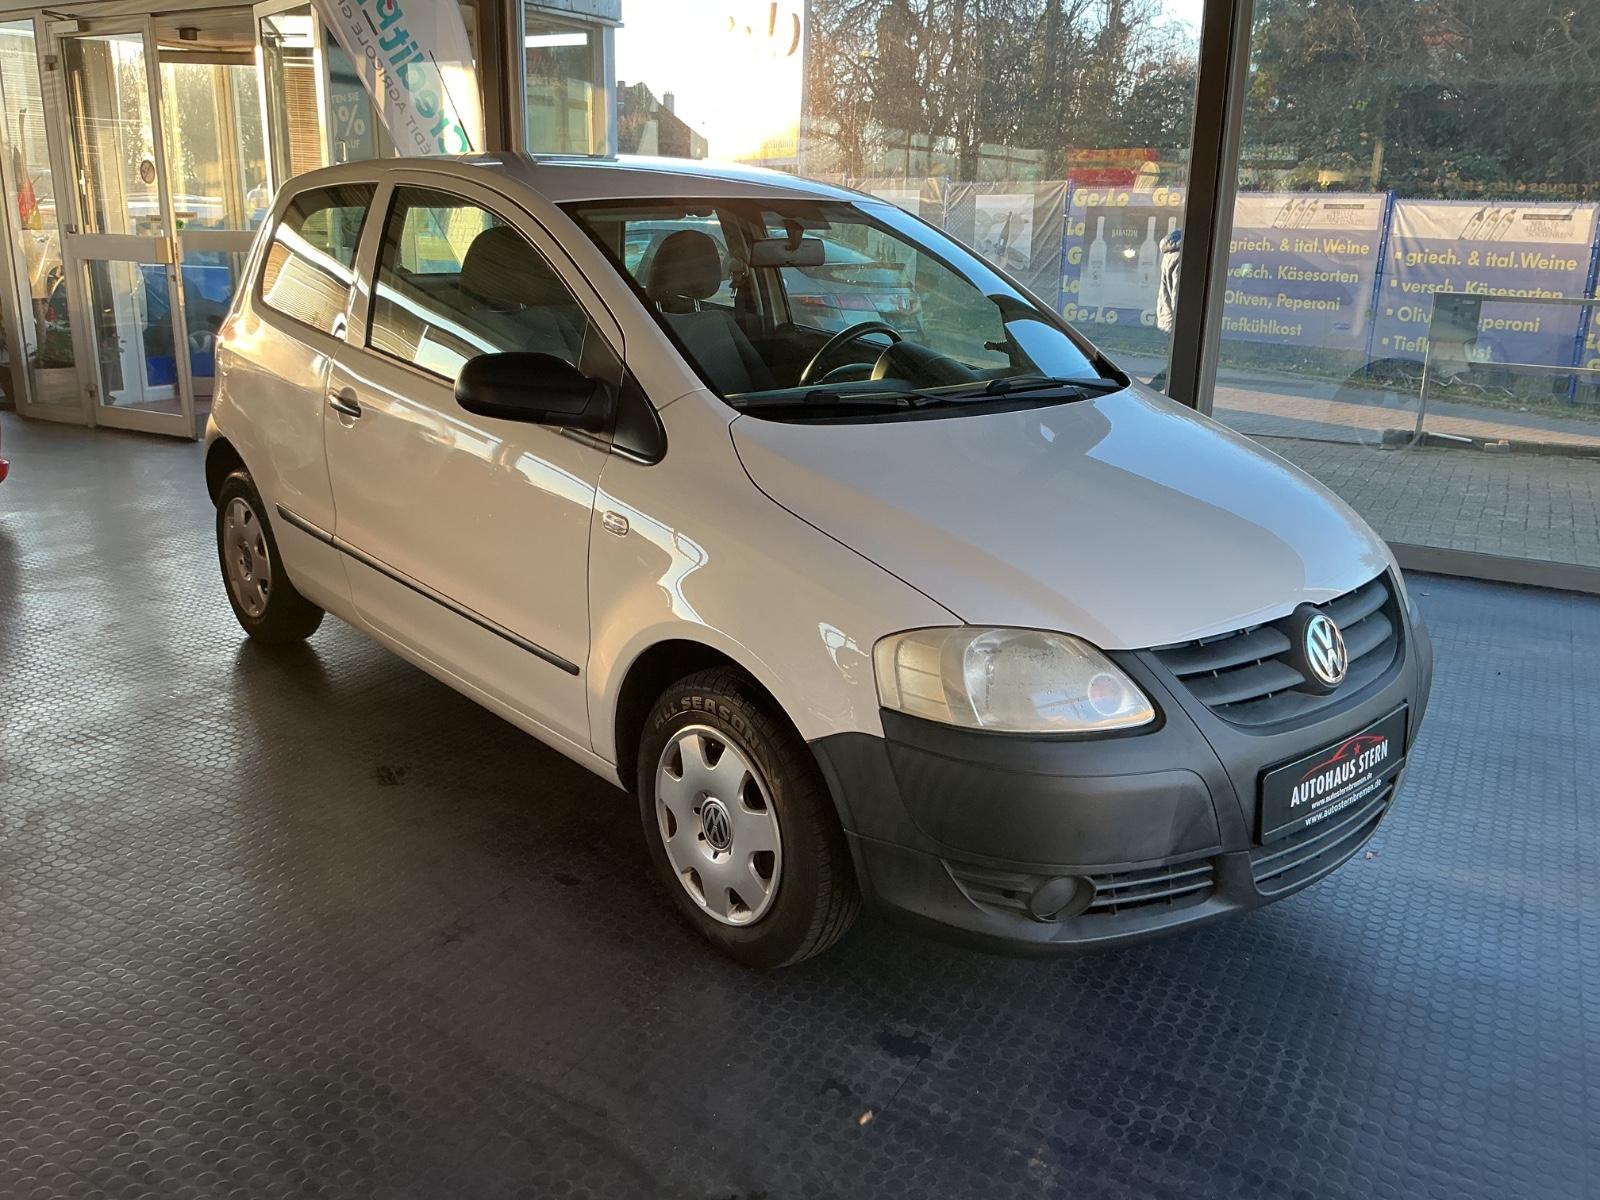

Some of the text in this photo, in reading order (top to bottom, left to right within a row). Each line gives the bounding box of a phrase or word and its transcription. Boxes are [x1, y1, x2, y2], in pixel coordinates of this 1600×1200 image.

[1229, 237, 1274, 253] griech.
[1279, 238, 1290, 251] &
[1405, 249, 1461, 267] griech.
[1467, 251, 1480, 265] &
[1226, 264, 1359, 283] versch. Käsesorten
[1224, 290, 1341, 312] Oliven, Peperoni
[680, 695, 762, 751] SEASON
[1290, 739, 1389, 808] AUTOHAUS STERN
[1304, 778, 1382, 826] www.autosternbremen.de
[1311, 772, 1373, 810] www.autosternbremen.de
